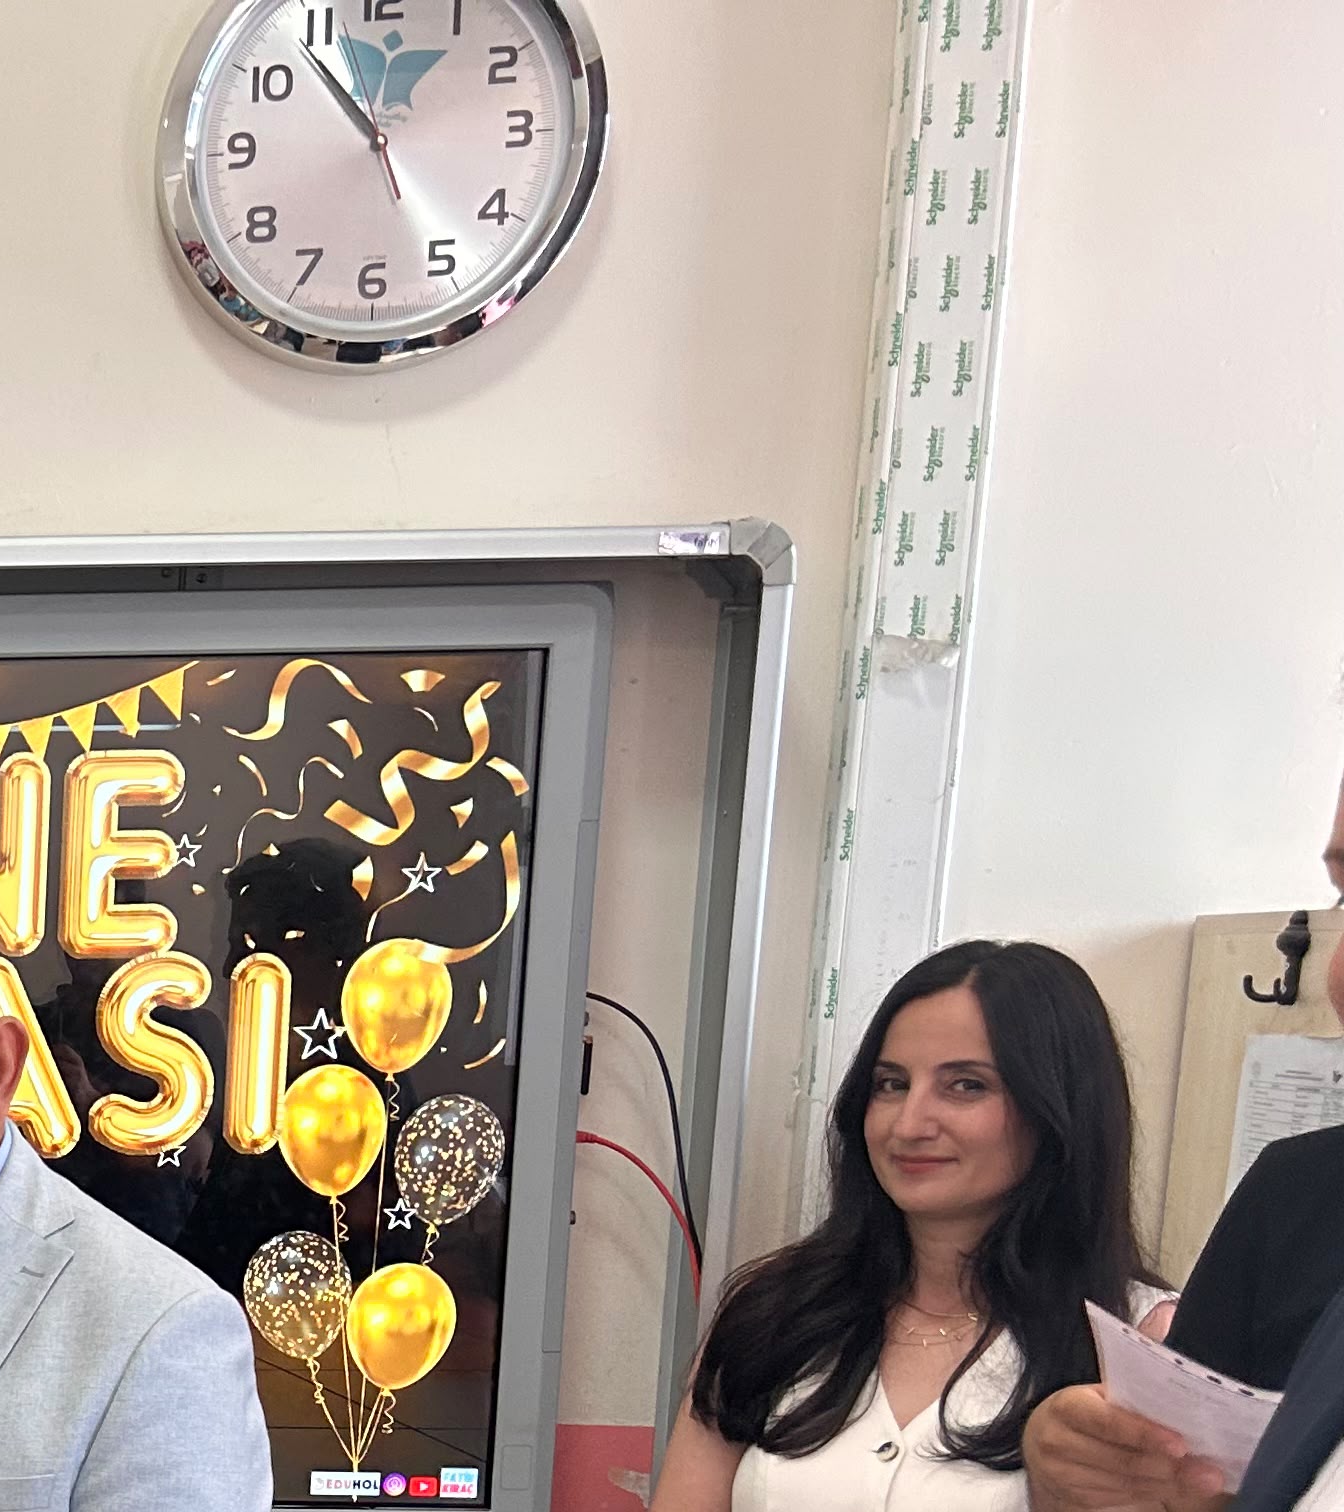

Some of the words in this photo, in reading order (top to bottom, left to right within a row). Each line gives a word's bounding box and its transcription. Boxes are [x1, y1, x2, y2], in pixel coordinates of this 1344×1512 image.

[307, 8, 333, 46] 11
[940, 0, 954, 52] Schneide
[981, 0, 995, 52] Schneide
[251, 63, 293, 103] 10
[487, 45, 519, 85] 2
[505, 109, 534, 149] 3
[227, 131, 256, 169] 9
[245, 205, 277, 243] 8
[477, 188, 509, 226] 4
[295, 247, 324, 286] 7
[428, 239, 456, 277] 5
[358, 262, 386, 300] 6
